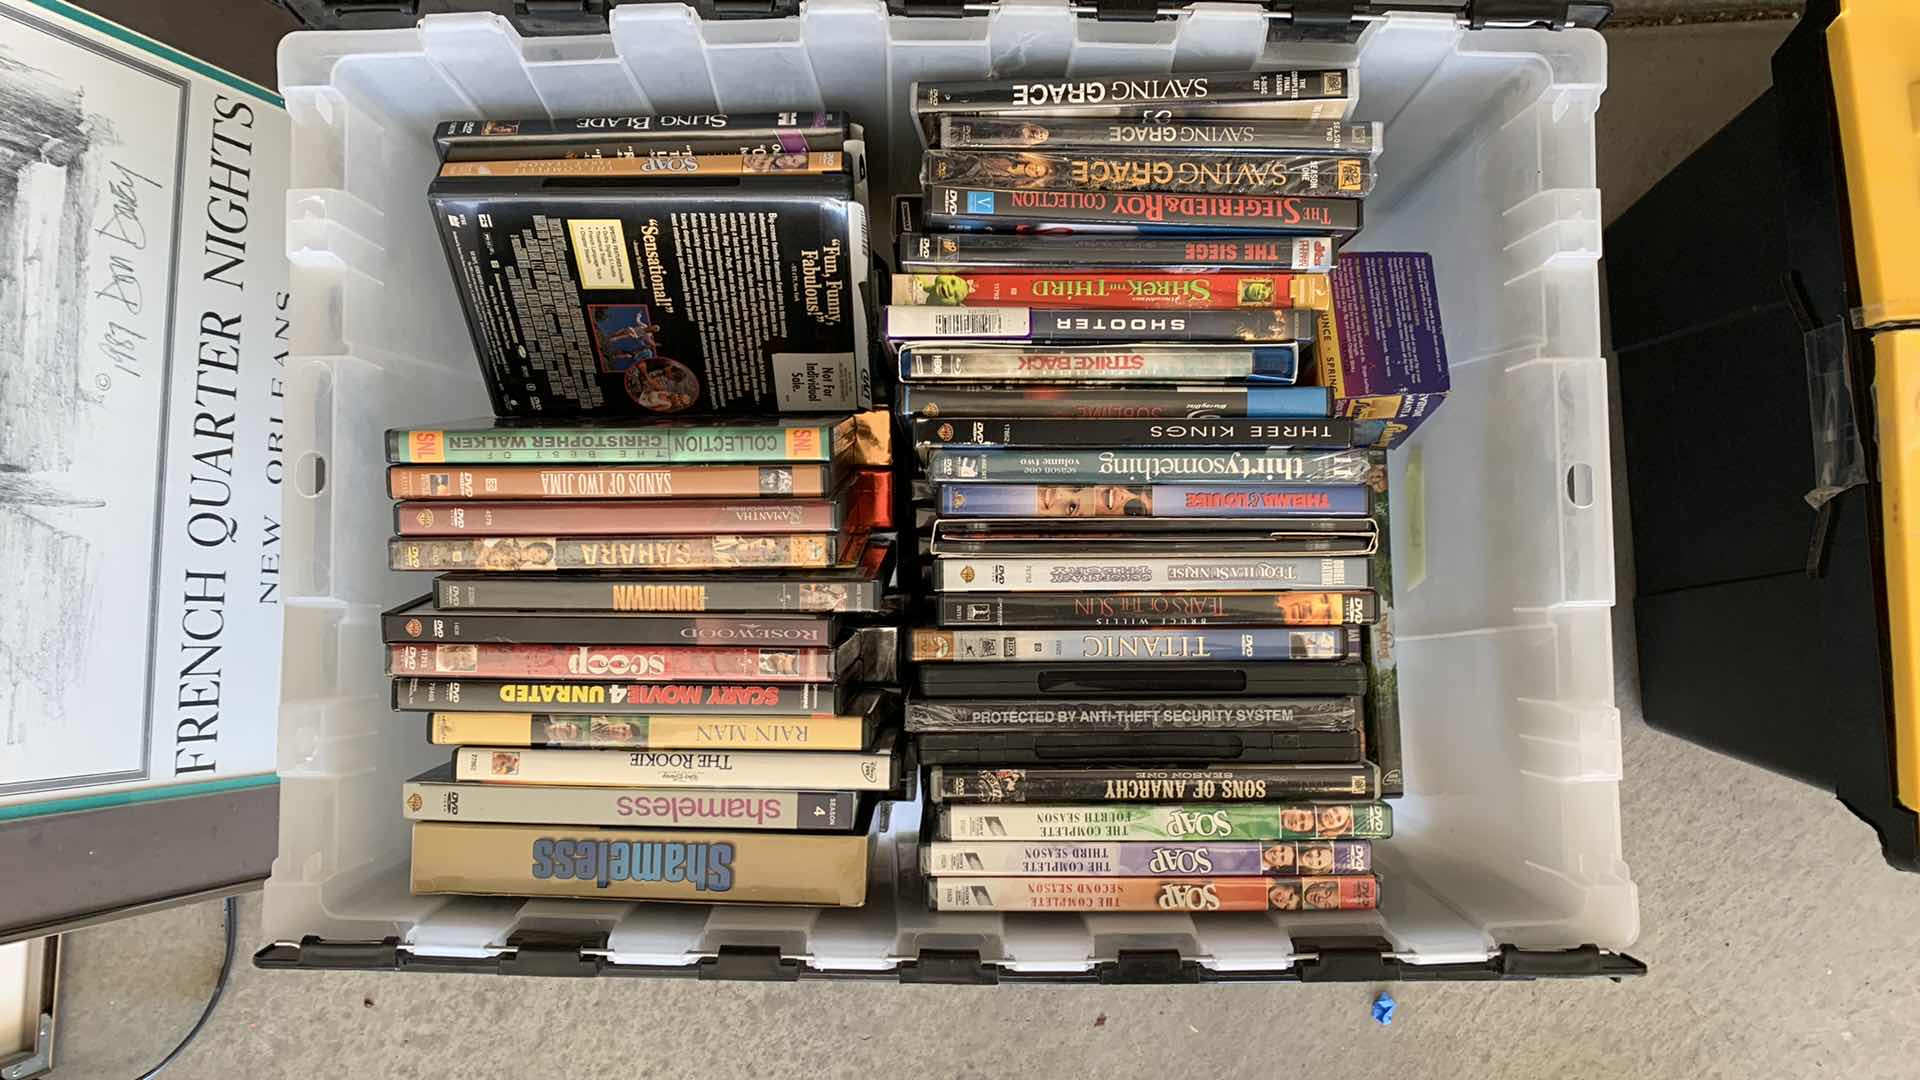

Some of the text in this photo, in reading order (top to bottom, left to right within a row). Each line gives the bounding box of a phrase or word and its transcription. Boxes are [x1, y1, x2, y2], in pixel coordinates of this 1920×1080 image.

[1012, 79, 1208, 106] SAVING GRACE
[576, 113, 728, 131] SLING BLADE
[1109, 126, 1254, 142] SAVING GRACE
[1333, 121, 1341, 148] SEASON
[640, 156, 699, 174] SOAP
[1072, 160, 1286, 186] SAVING GRACE
[1302, 167, 1310, 181] ONE
[1310, 161, 1319, 189] SEASON
[948, 189, 958, 216] DVD
[1012, 192, 1105, 210] COLLECTION
[1303, 208, 1331, 225] THE
[922, 238, 930, 258] DVD
[1184, 243, 1278, 260] THE SIEGE
[640, 218, 674, 313] “Sensational!”
[825, 280, 844, 326] Funny,
[1057, 319, 1185, 330] SHOOTER
[1320, 311, 1333, 342] UNCE
[1018, 355, 1144, 370] STRIKE BACK
[791, 372, 805, 393] Sale.
[806, 362, 822, 402] Individual
[822, 367, 835, 397] Not For
[174, 95, 254, 777] FRENCH QUARTER NIGHTS
[448, 434, 660, 450] CHRISTOPHER WALKEN
[793, 429, 812, 455] SNL
[976, 422, 984, 443] DVD
[1150, 426, 1332, 438] THREE KINGS
[416, 432, 437, 459] SNL
[674, 434, 777, 454] COLLECTION
[487, 450, 663, 459] THE BEST OF
[1020, 458, 1080, 467] volume two
[1023, 466, 1042, 474] one
[1098, 452, 1304, 481] thirtysomething
[462, 472, 473, 497] DVD
[540, 472, 672, 495] SANDS OF IWO JIMA
[1185, 493, 1249, 508] LOUISE
[1263, 493, 1329, 508] THELMA
[456, 508, 465, 528] DVD
[736, 510, 802, 525] SAMANTHA
[259, 515, 282, 604] NEW
[580, 543, 691, 565] SAHARA
[997, 565, 1005, 585] DVD
[1168, 562, 1296, 581] TEQUILA SUNRISE
[1321, 558, 1333, 585] FEATURE
[1333, 559, 1345, 585] DOUBLE
[613, 585, 704, 611] RUNDOWN
[1073, 597, 1224, 617] TEARS OF THE SUN
[1353, 598, 1363, 624] DVD
[436, 619, 444, 638] DVD
[680, 627, 818, 641] ROSEWOOD
[1082, 635, 1211, 658] TITANIC
[1244, 634, 1253, 657] DVD
[407, 646, 416, 670] DVD
[451, 682, 460, 703] DVD
[499, 684, 605, 704] UNRATED
[608, 684, 627, 704] 4
[627, 685, 703, 705] MOVIE
[706, 686, 780, 706] SCARY
[972, 709, 1293, 724] PROTECTED BY ANTI-THEFT SECURITY SYSTEM
[696, 724, 809, 743] RAIN MAN
[630, 752, 733, 770] THE ROOKIE
[1104, 779, 1265, 799] SONS OF ANARCHY
[450, 791, 459, 816] DVD
[616, 796, 781, 825] shameless
[813, 806, 826, 817] 4
[828, 797, 836, 826] SEASON
[1036, 812, 1131, 823] FOURTH SEASON
[1167, 810, 1232, 838] SOAP
[1373, 806, 1382, 832] DVD
[1040, 825, 1128, 837] THE COMPLETE
[1024, 848, 1108, 858] THIRD SEASON
[1149, 847, 1213, 874] SOAP
[1354, 845, 1364, 871] DVD
[532, 838, 735, 893] Shameless
[1022, 861, 1111, 872] THE COMPLETE
[1028, 883, 1123, 893] SECOND SEASON
[1158, 883, 1220, 910] SOAP
[1030, 897, 1120, 907] THE COMPLETE
